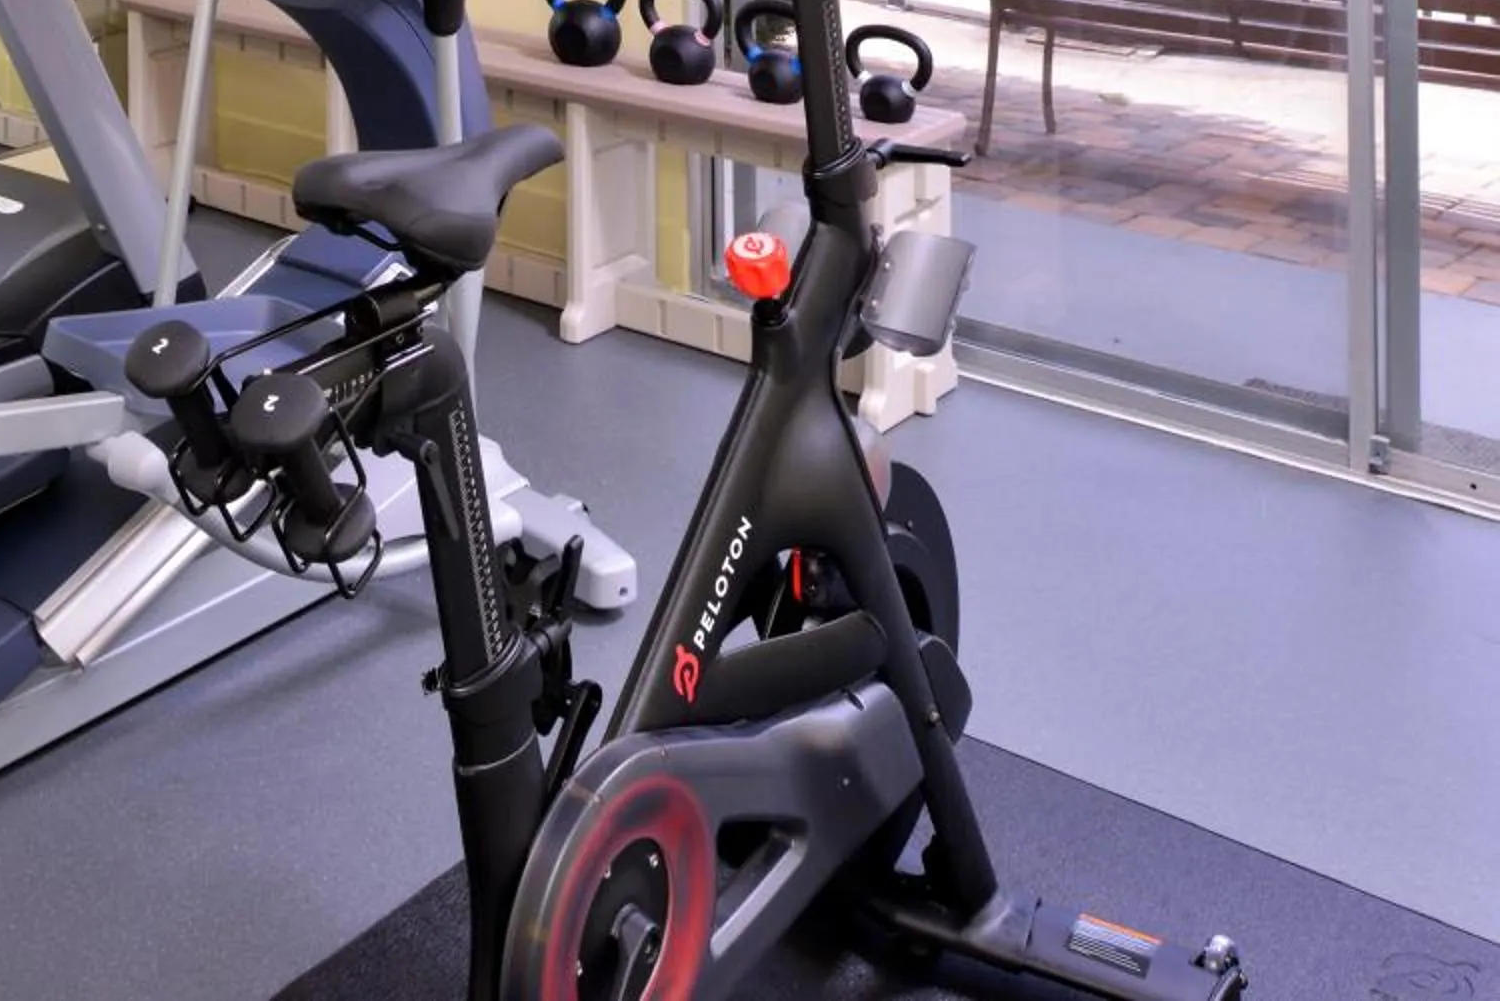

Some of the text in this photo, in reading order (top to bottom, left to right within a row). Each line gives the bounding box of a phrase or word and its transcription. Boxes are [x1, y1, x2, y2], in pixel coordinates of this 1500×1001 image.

[151, 337, 169, 355] 2
[263, 394, 279, 412] 2
[693, 516, 752, 649] PELOTON
